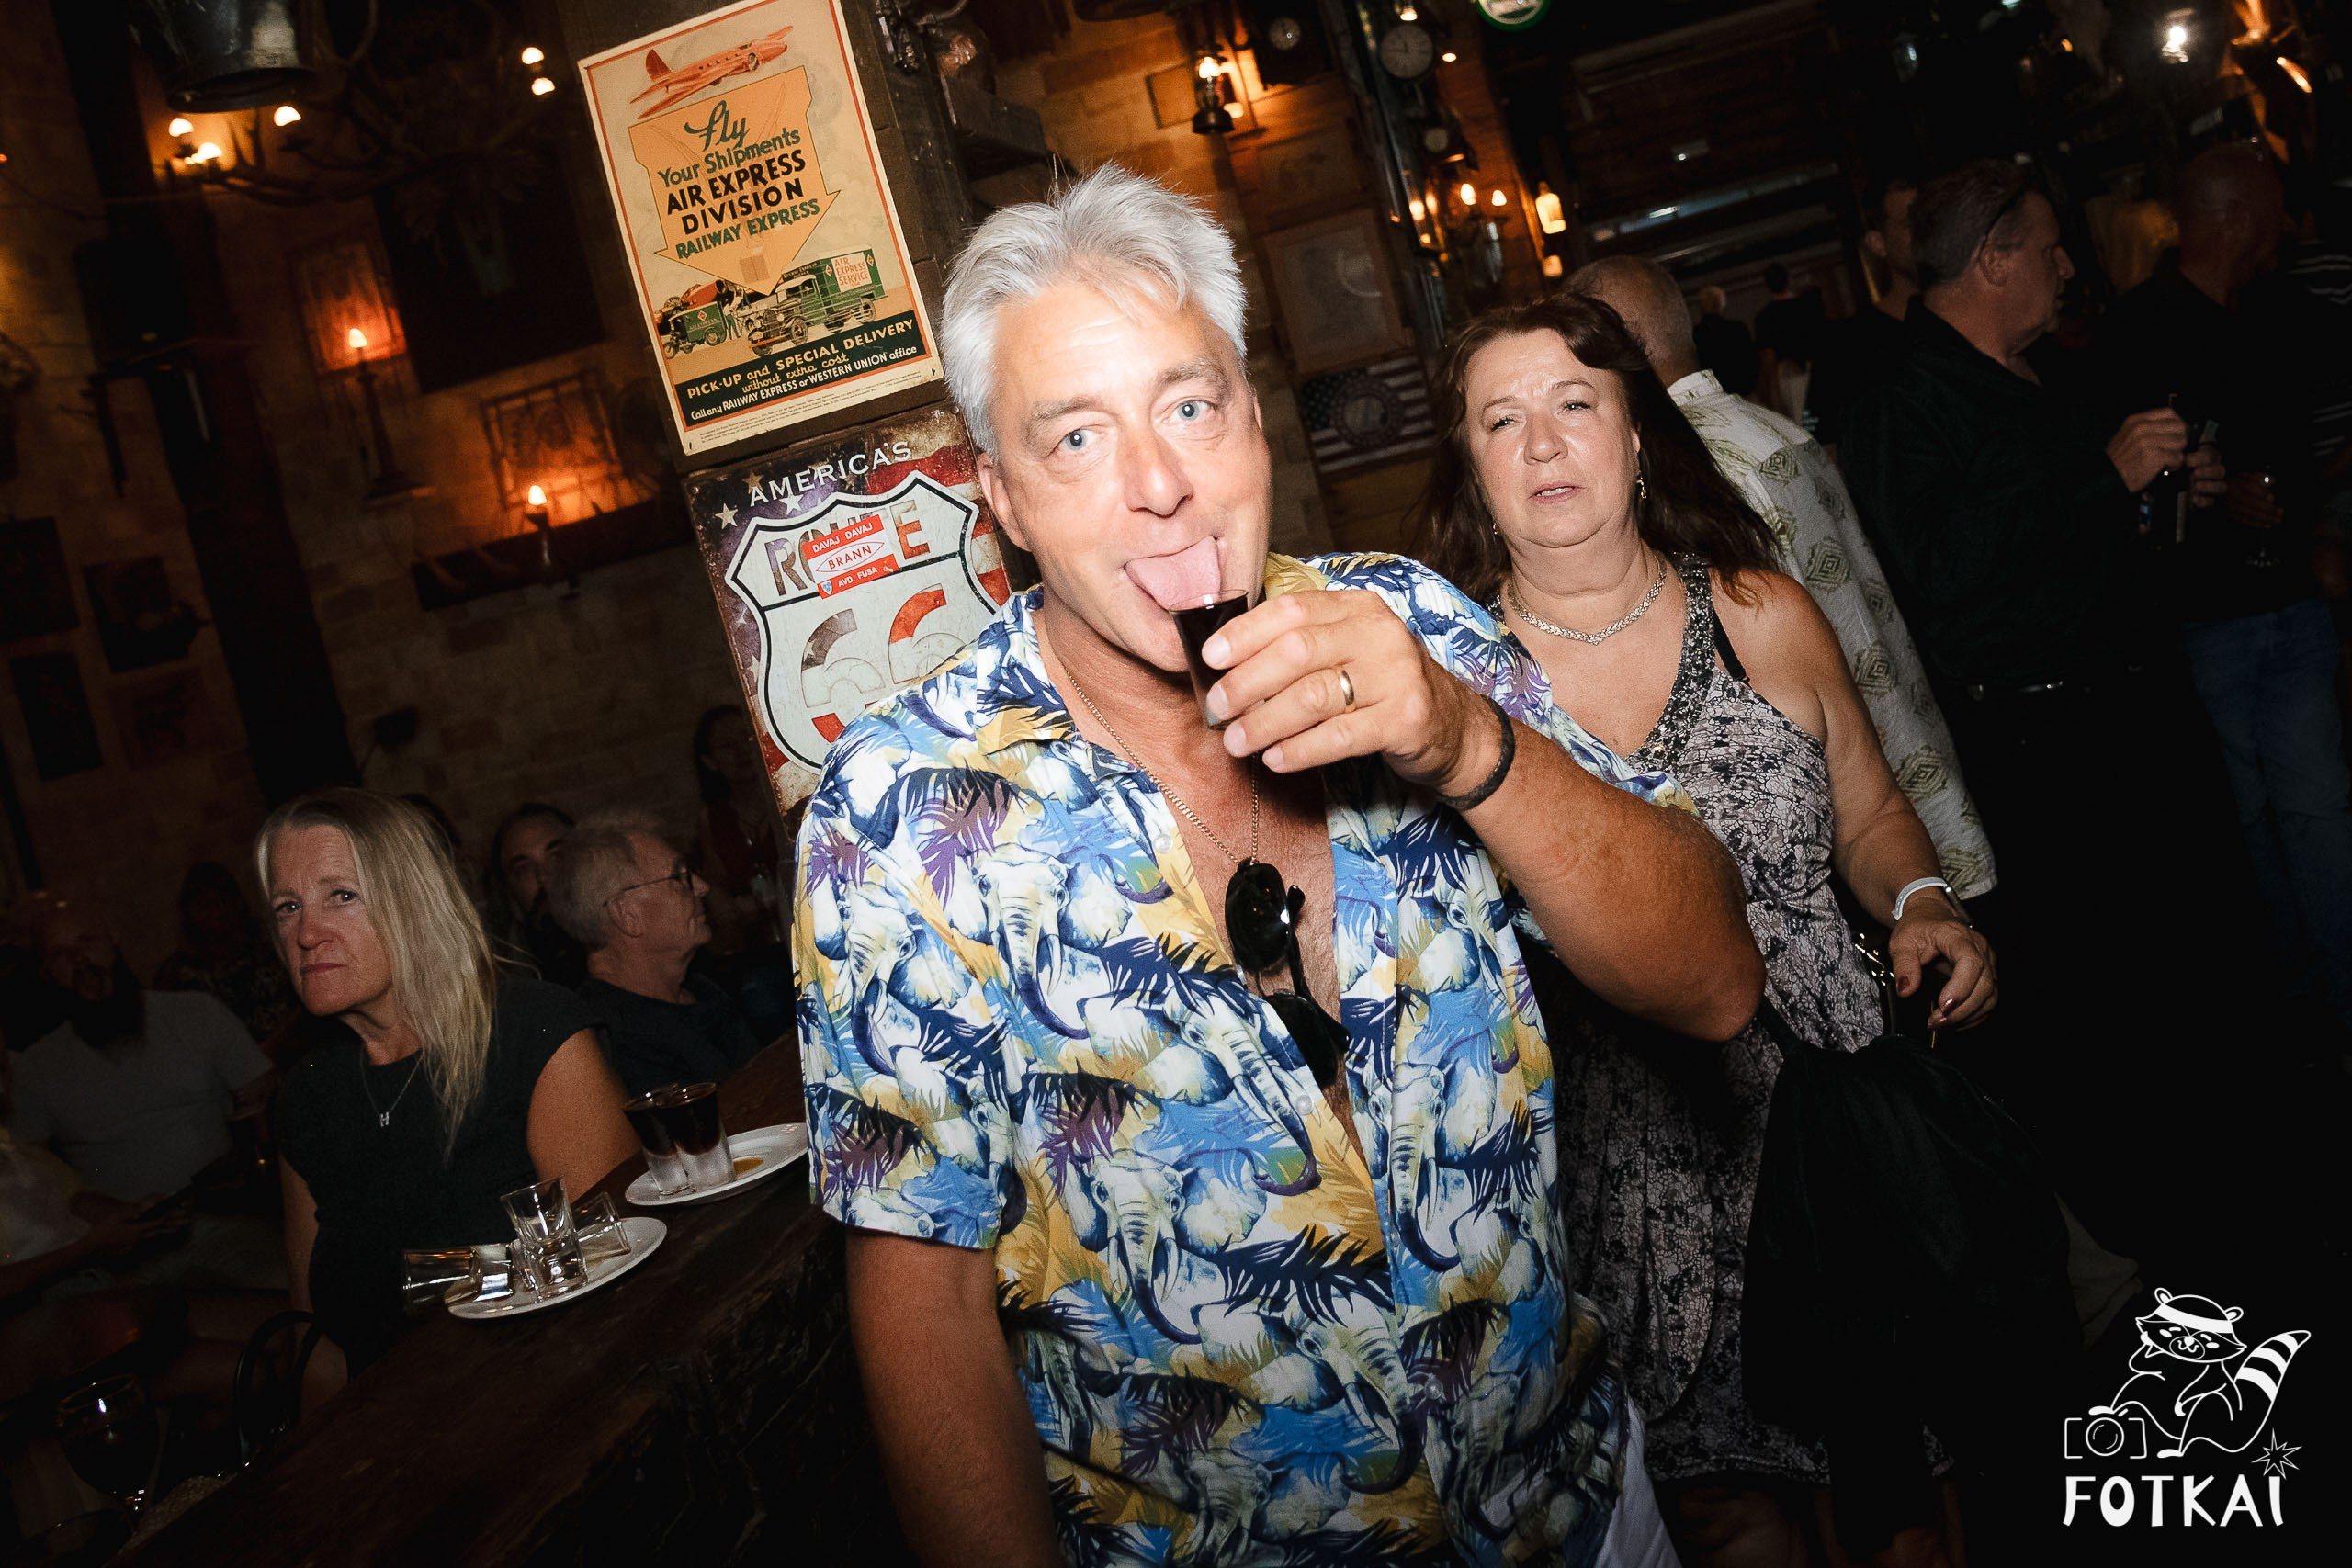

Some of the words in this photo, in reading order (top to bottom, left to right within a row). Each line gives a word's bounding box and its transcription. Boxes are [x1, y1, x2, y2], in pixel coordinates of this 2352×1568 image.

[684, 100, 750, 152] Fly
[657, 163, 700, 187] Your
[704, 127, 801, 174] Shipments
[667, 185, 706, 215] AIR
[708, 149, 806, 199] EXPRESS
[676, 223, 741, 259] RAILWAY
[747, 198, 820, 235] EXPRESS
[682, 177, 804, 235] DIVISION
[834, 257, 850, 266] AIR
[836, 263, 866, 276] EXPRESS
[839, 271, 868, 286] SERVICE
[686, 373, 742, 399] PICK-UP
[746, 364, 771, 380] and
[775, 344, 839, 371] SPECIAL
[842, 319, 913, 350] DELIVERY
[691, 408, 707, 421] Call
[707, 405, 723, 416] any
[722, 391, 759, 412] RAILWAY
[760, 379, 797, 400] EXPRESS
[798, 378, 808, 388] or
[808, 363, 854, 384] WESTERN
[854, 352, 887, 371] UNION
[888, 346, 917, 360] office
[741, 372, 781, 393] without
[786, 365, 817, 379] extra
[821, 352, 850, 367] cost
[750, 441, 912, 507] AMERICA'S
[811, 536, 841, 553] DAVAJ
[844, 523, 873, 539] DAVAJ
[828, 545, 872, 570] BRANN
[838, 576, 855, 588] AVD.
[856, 566, 878, 580] FUSA
